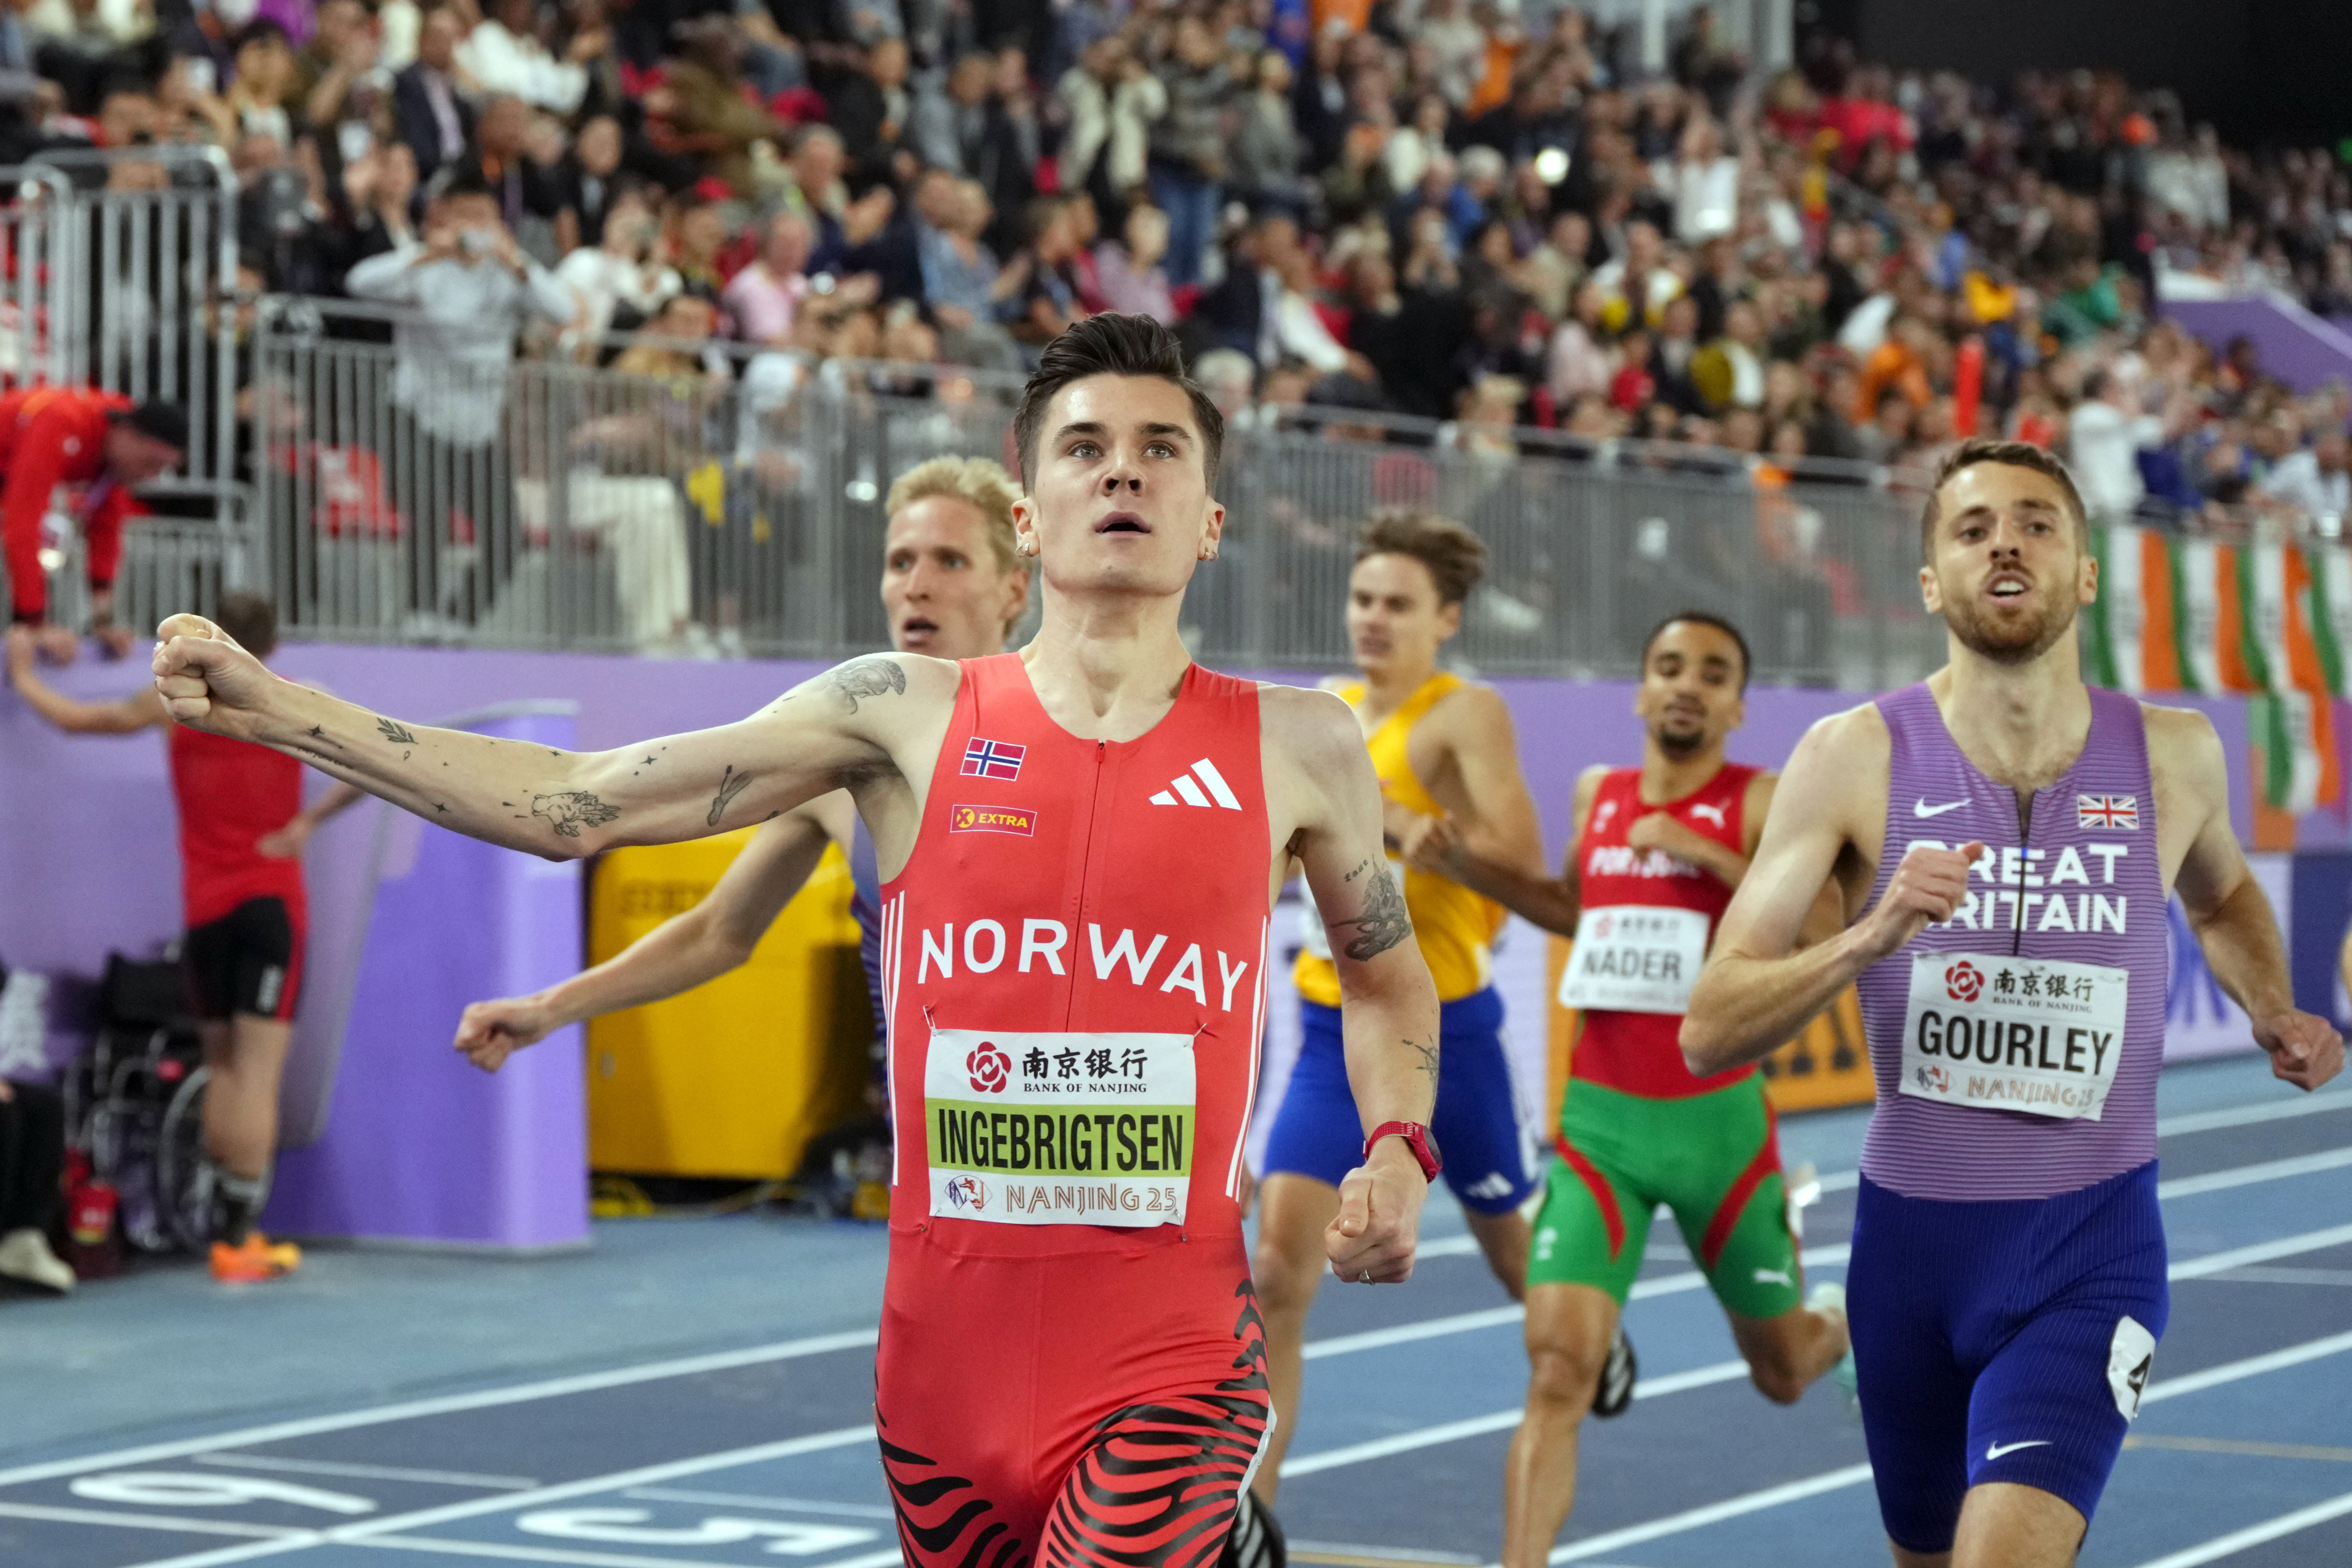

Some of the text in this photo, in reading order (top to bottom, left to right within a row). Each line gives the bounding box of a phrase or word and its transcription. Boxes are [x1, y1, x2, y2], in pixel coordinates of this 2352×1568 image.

[978, 813, 1028, 828] EXTRA
[1907, 840, 2128, 887] REAT
[1926, 891, 2127, 934] RITAIN
[917, 918, 1248, 1012] NORWAY
[1583, 949, 1682, 982] NADER
[1994, 967, 2094, 1003] 南京银行
[1993, 996, 2092, 1014] BANK OF NANJING
[1918, 1011, 2113, 1075] GOURLEY
[1022, 1047, 1148, 1079] 南京银行
[1024, 1083, 1147, 1094] BANK OF NANJING
[1968, 1075, 2076, 1107] NANJING
[939, 1109, 1183, 1171] INGEBRIGTSEN
[1006, 1184, 1176, 1216] NANJING 25
[517, 1508, 881, 1555] 5
